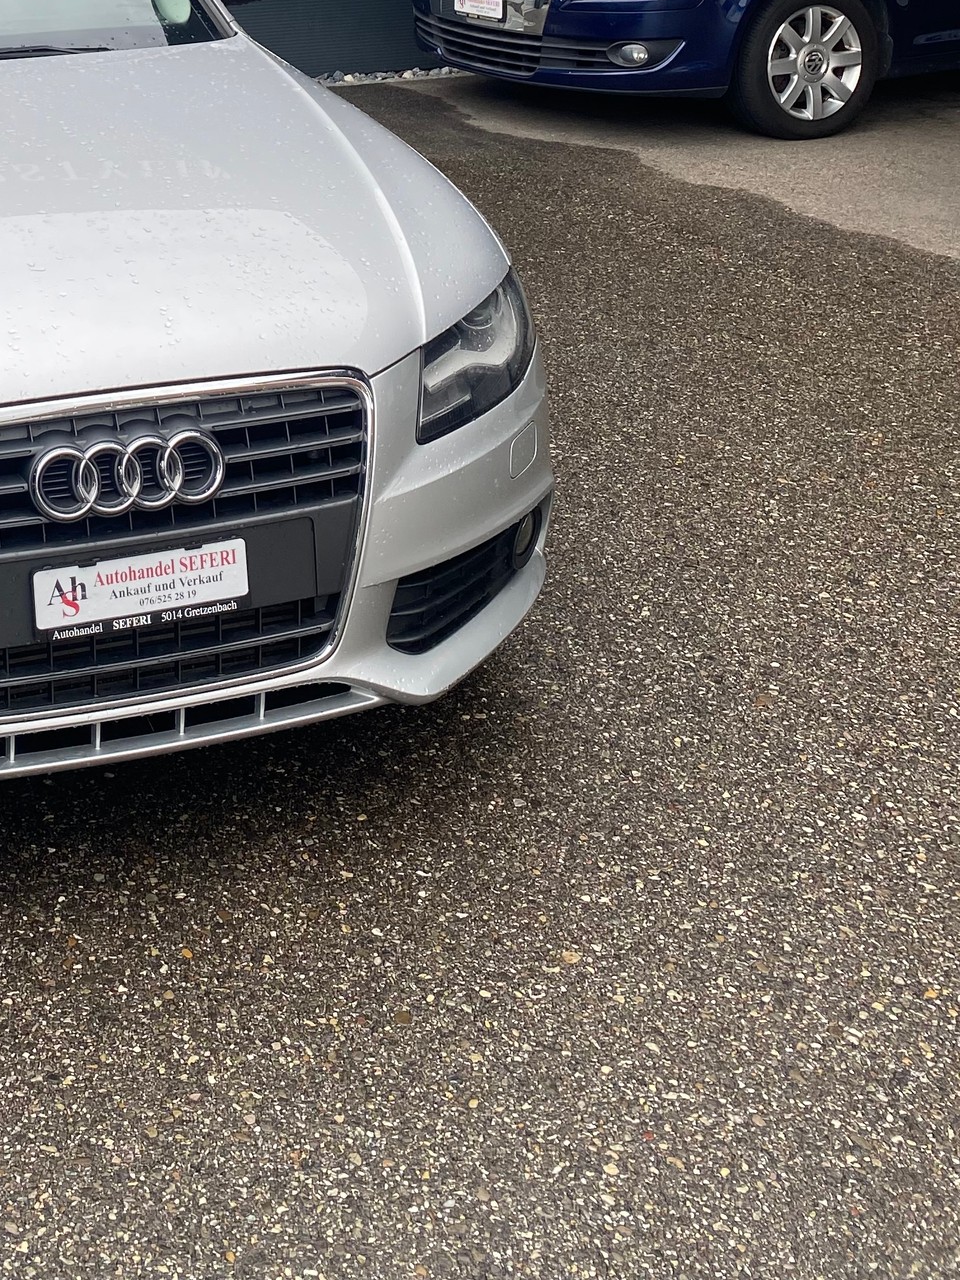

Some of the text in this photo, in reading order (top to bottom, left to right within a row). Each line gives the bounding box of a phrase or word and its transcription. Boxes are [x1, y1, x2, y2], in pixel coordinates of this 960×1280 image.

[93, 548, 237, 587] Autohandel SEFERI
[109, 571, 224, 600] Ankauf und Verkauf
[139, 589, 197, 607] 076/525 28 19
[52, 600, 238, 640] Autohandel SEFERI 5014 Gretzenbach
